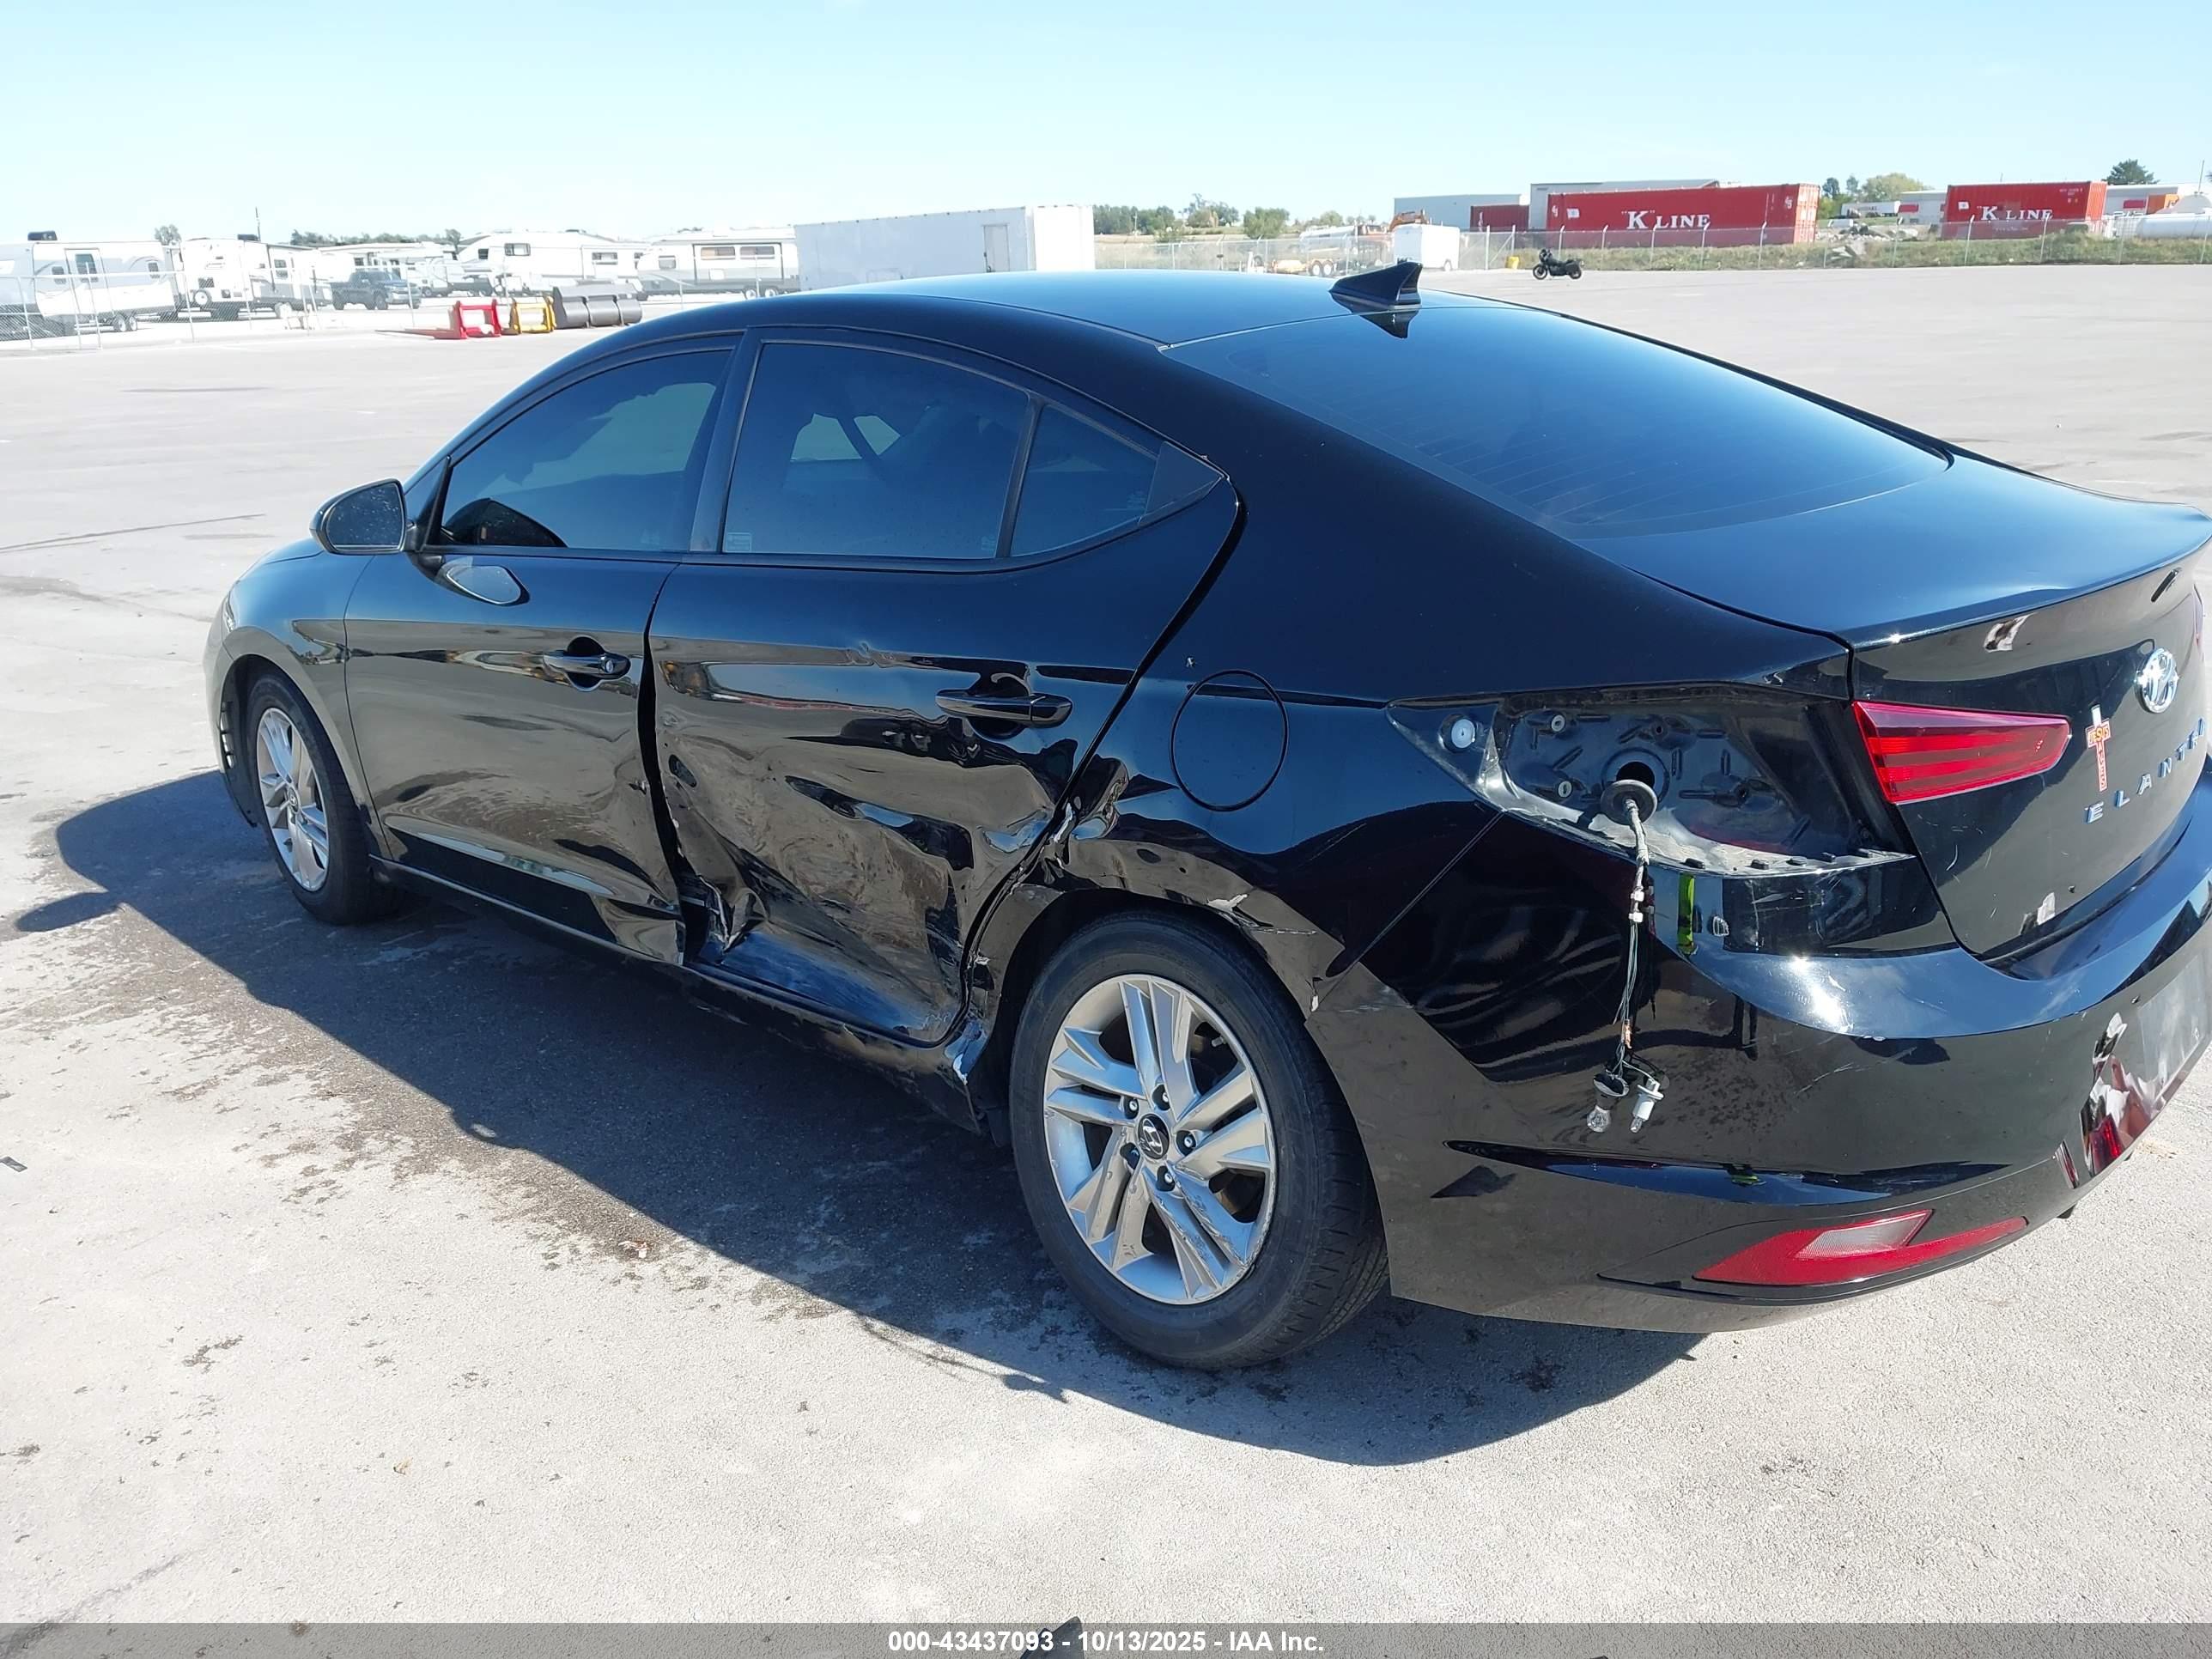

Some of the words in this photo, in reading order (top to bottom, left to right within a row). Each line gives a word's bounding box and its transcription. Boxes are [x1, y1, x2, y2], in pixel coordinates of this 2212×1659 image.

[1656, 215, 1711, 228] LINE
[2005, 209, 2052, 221] LINE
[2087, 726, 2110, 744] JESUS
